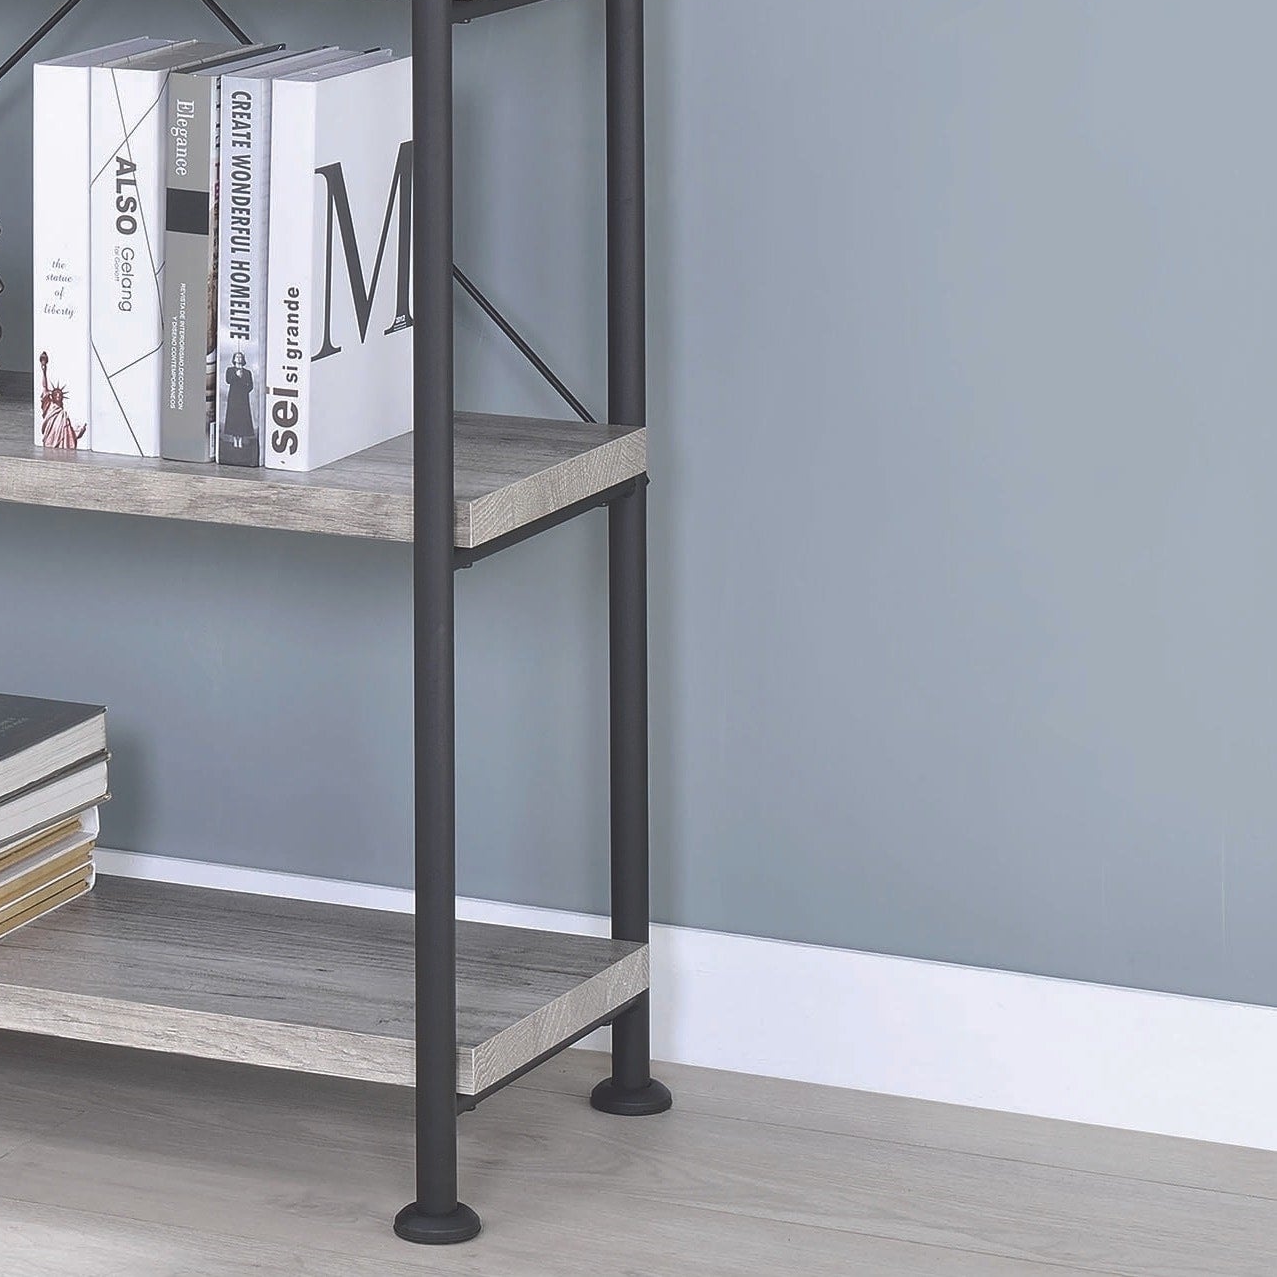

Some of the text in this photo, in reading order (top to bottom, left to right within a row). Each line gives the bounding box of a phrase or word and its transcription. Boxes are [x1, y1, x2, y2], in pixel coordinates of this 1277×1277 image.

[170, 99, 195, 176] Elegance
[115, 155, 137, 235] ALSO
[229, 90, 252, 341] CREATE WONDERFUL HOMELIFE
[45, 272, 73, 283] statue
[51, 258, 65, 270] the
[118, 247, 135, 312] Gelang
[311, 140, 413, 363] M
[43, 303, 74, 319] liberty
[54, 286, 64, 300] of
[265, 386, 299, 455] sei
[283, 286, 302, 359] grande
